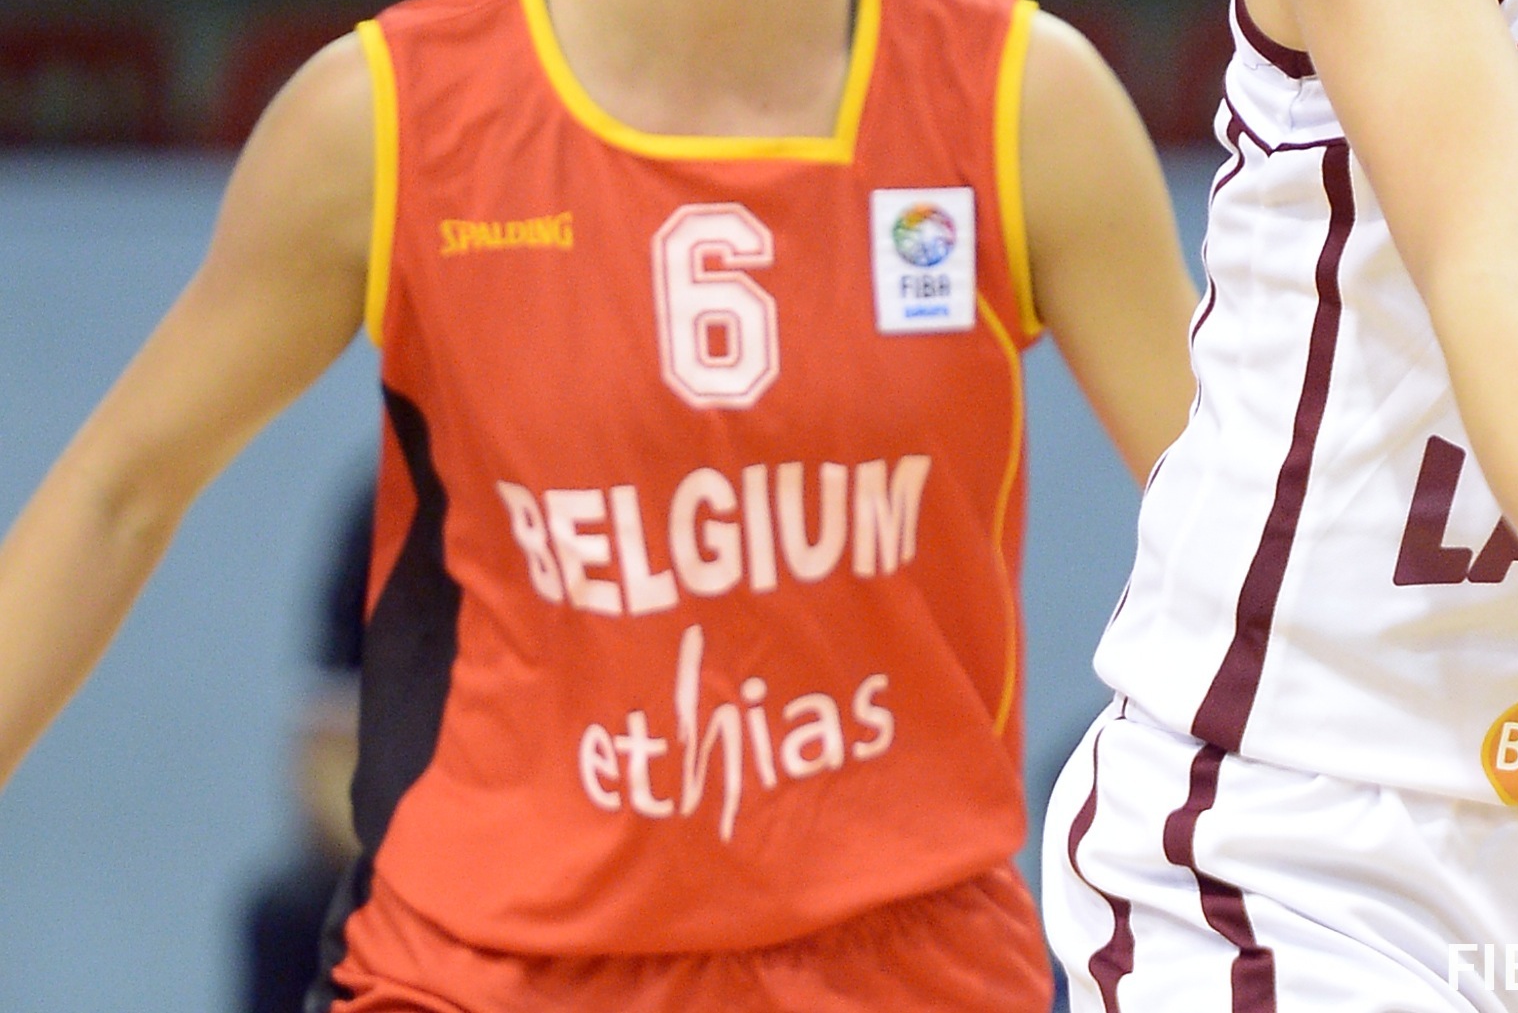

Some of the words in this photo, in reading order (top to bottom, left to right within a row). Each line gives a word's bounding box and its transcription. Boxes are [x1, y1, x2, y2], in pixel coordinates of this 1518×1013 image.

[439, 210, 574, 257] SPALDING
[651, 201, 780, 409] 6
[900, 273, 951, 299] FIBA
[497, 453, 932, 617] BELGIUM
[578, 624, 895, 844] ethias
